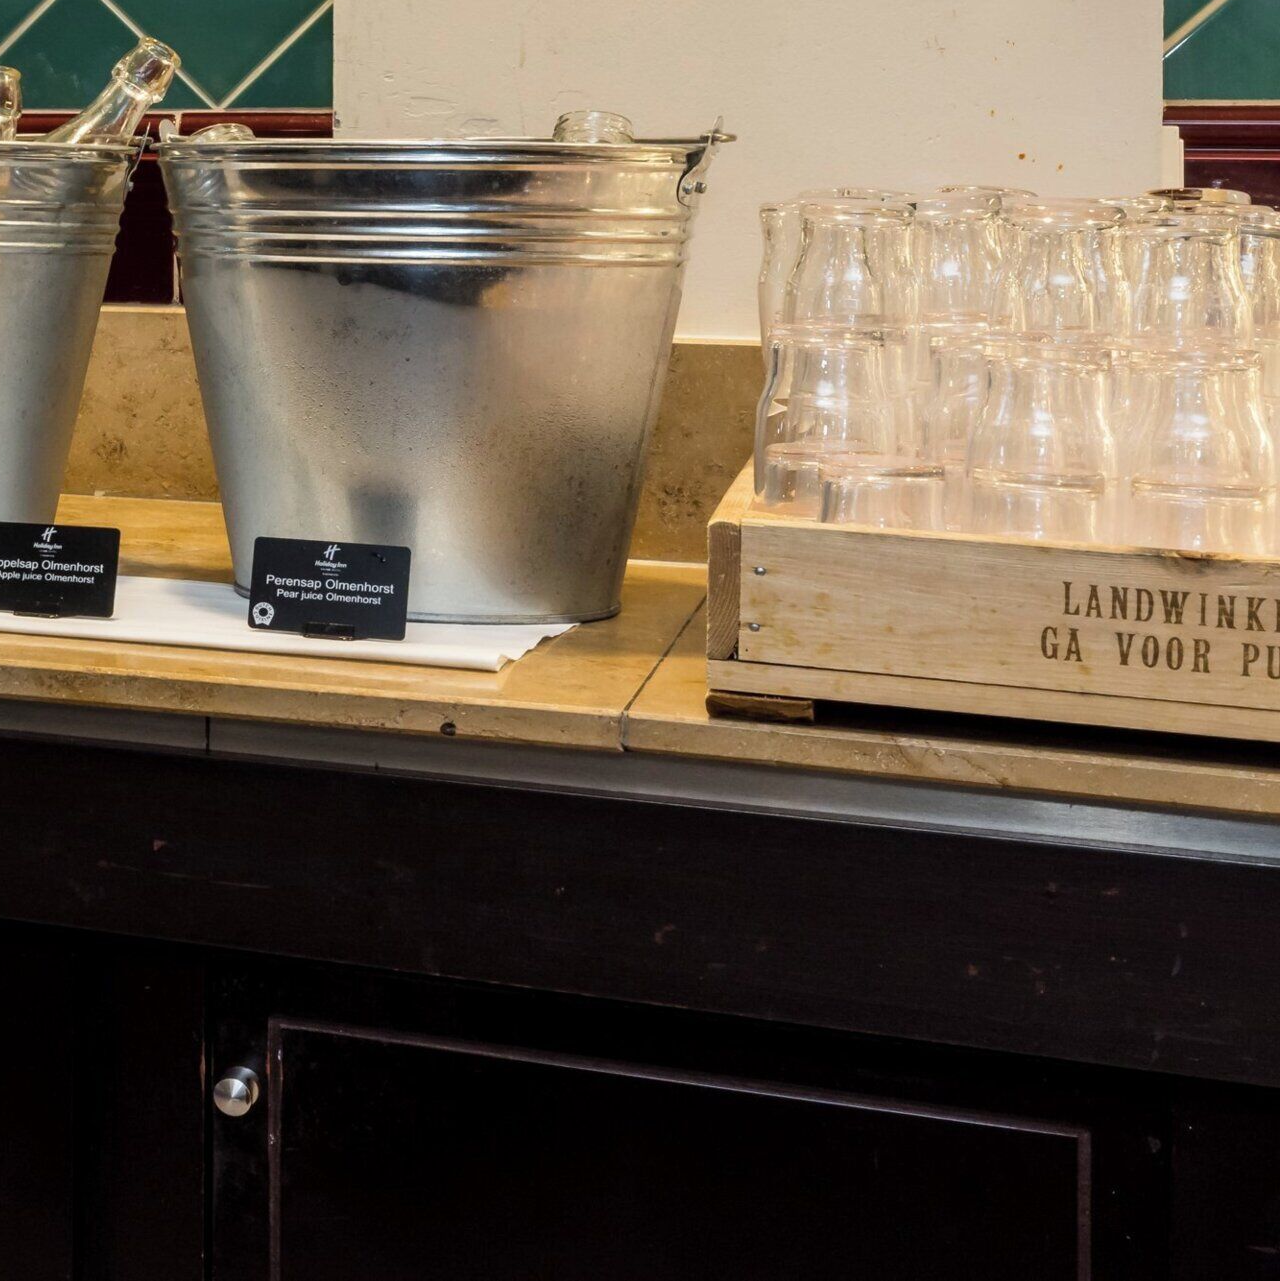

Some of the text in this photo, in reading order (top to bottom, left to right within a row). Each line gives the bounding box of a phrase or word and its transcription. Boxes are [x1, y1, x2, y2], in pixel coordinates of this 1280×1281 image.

[42, 560, 104, 573] Olmenhorst
[22, 572, 42, 581] juice
[44, 573, 95, 584] Olmenhorst
[266, 574, 394, 595] Perensap Olmenhorst
[276, 589, 381, 605] Pear juice Olmenhorst
[1040, 626, 1280, 680] GA VOOR PU
